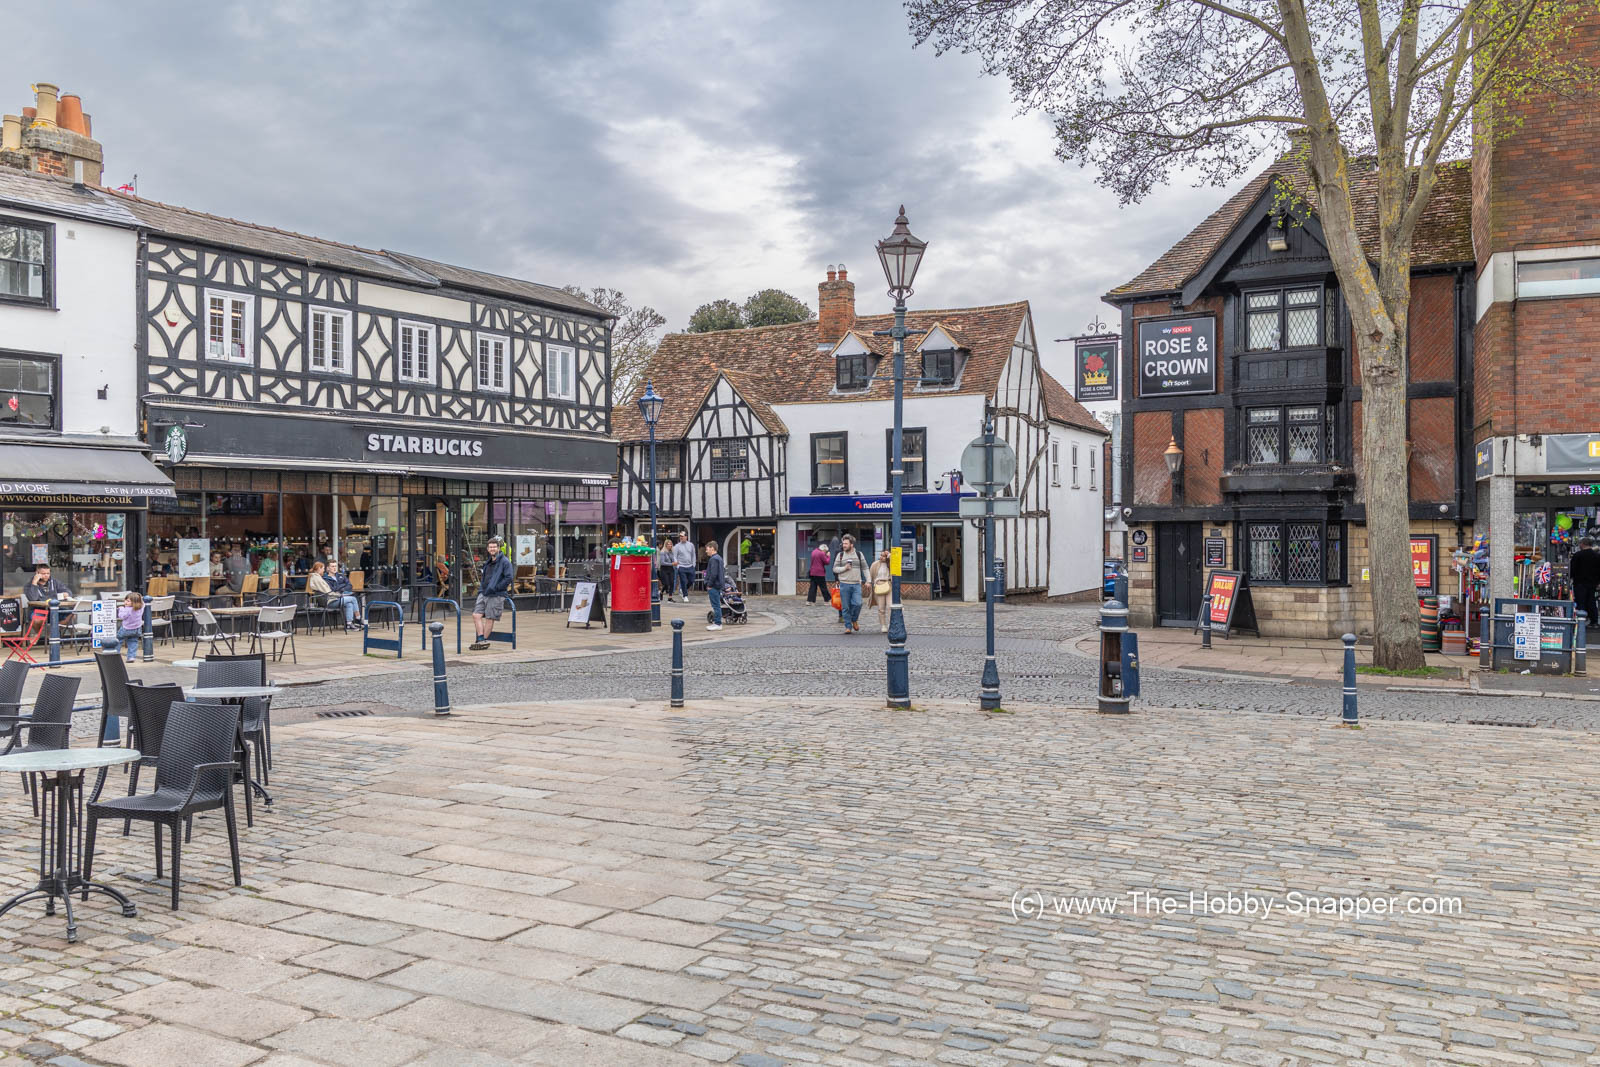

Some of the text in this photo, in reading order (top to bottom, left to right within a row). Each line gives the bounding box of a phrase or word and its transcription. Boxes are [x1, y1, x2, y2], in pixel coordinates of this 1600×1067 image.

[1145, 336, 1208, 356] ROSE &
[1144, 358, 1208, 377] CROWN
[367, 433, 483, 457] STARBUCKS
[0, 483, 51, 493] D MORE
[120, 487, 129, 495] IN
[863, 501, 893, 509] nationwi
[1410, 545, 1428, 553] LUE
[1213, 581, 1233, 590] VALUE
